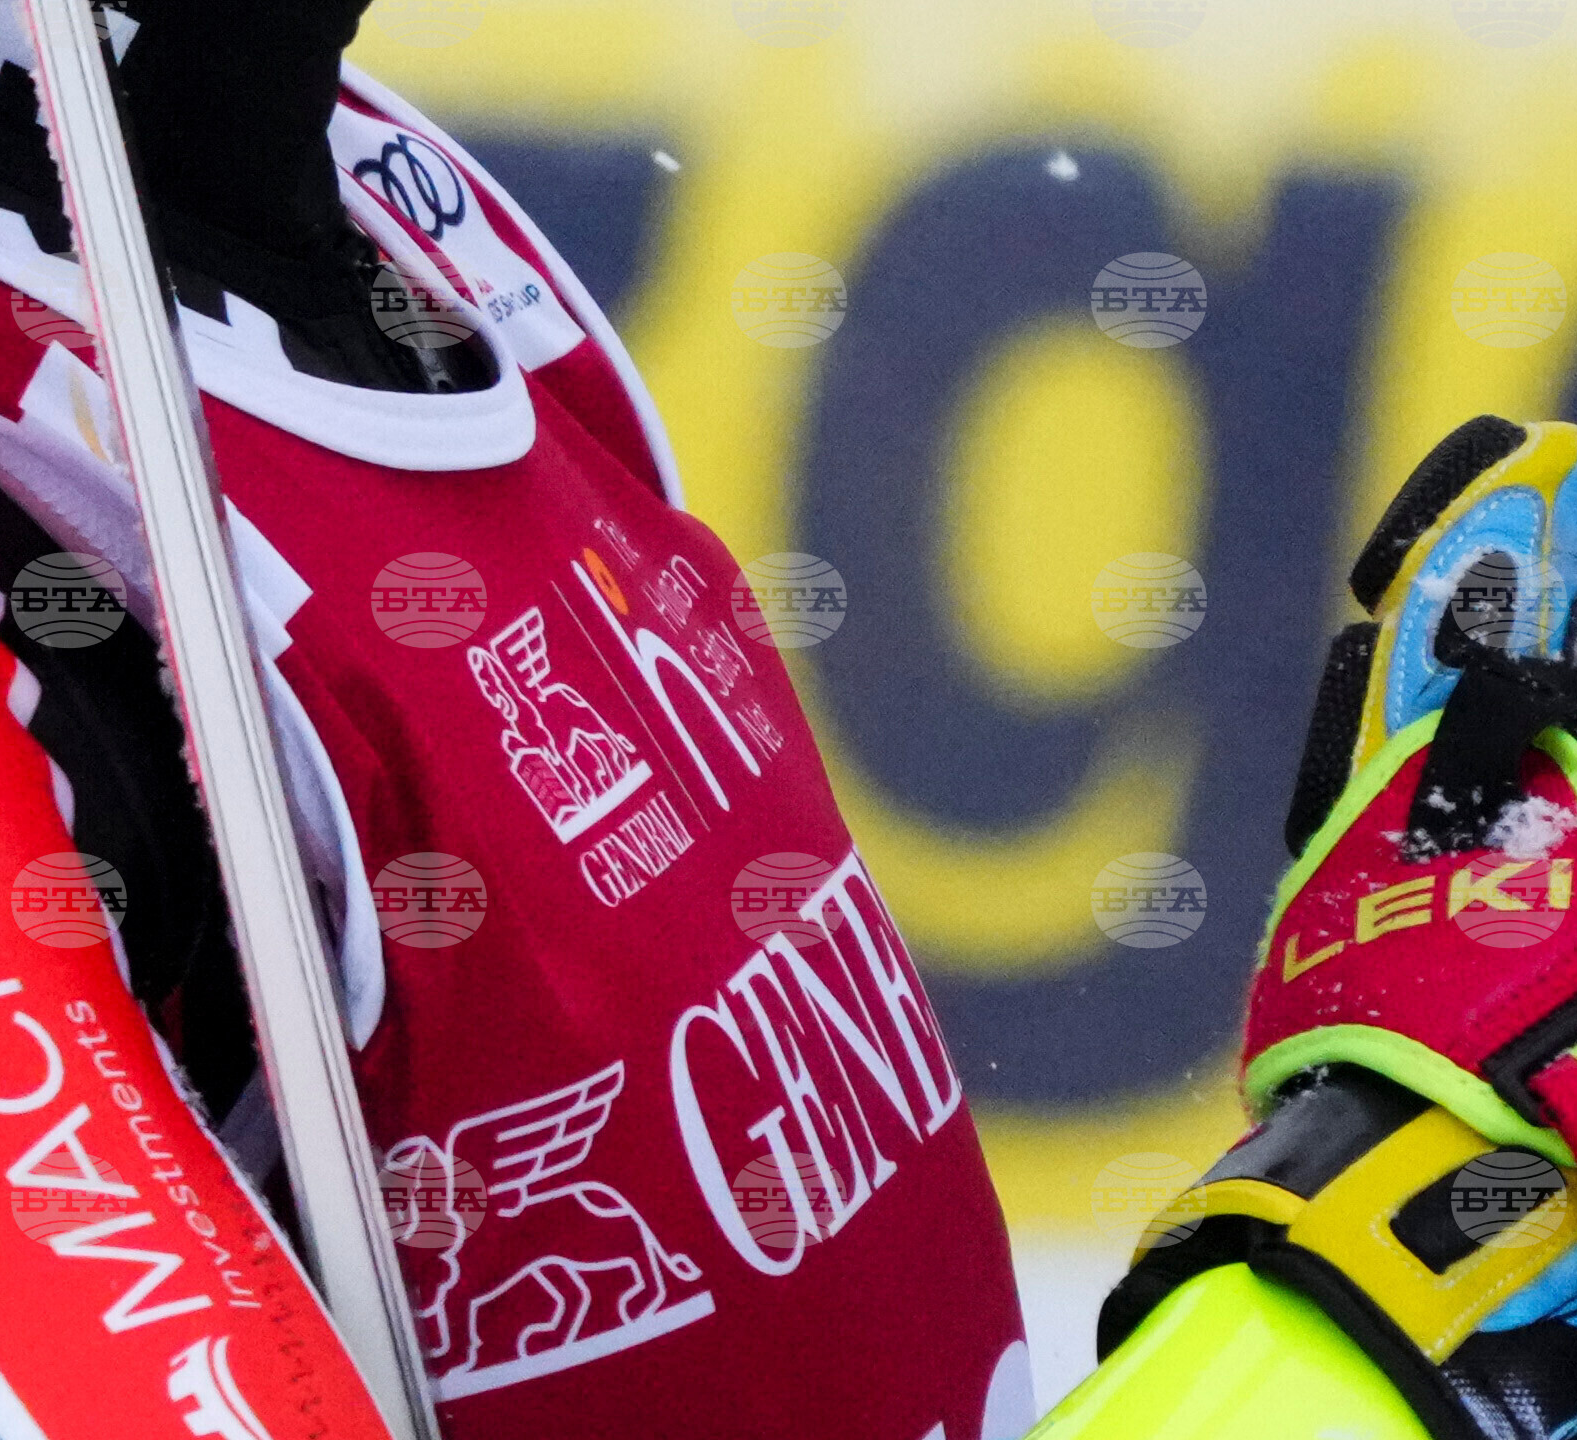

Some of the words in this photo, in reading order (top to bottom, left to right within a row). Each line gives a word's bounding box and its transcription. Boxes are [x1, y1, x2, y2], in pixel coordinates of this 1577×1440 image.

[579, 789, 694, 909] GENERALI
[1281, 858, 1575, 984] LEKI
[65, 998, 265, 1309] Investments
[669, 843, 963, 1278] GENE
